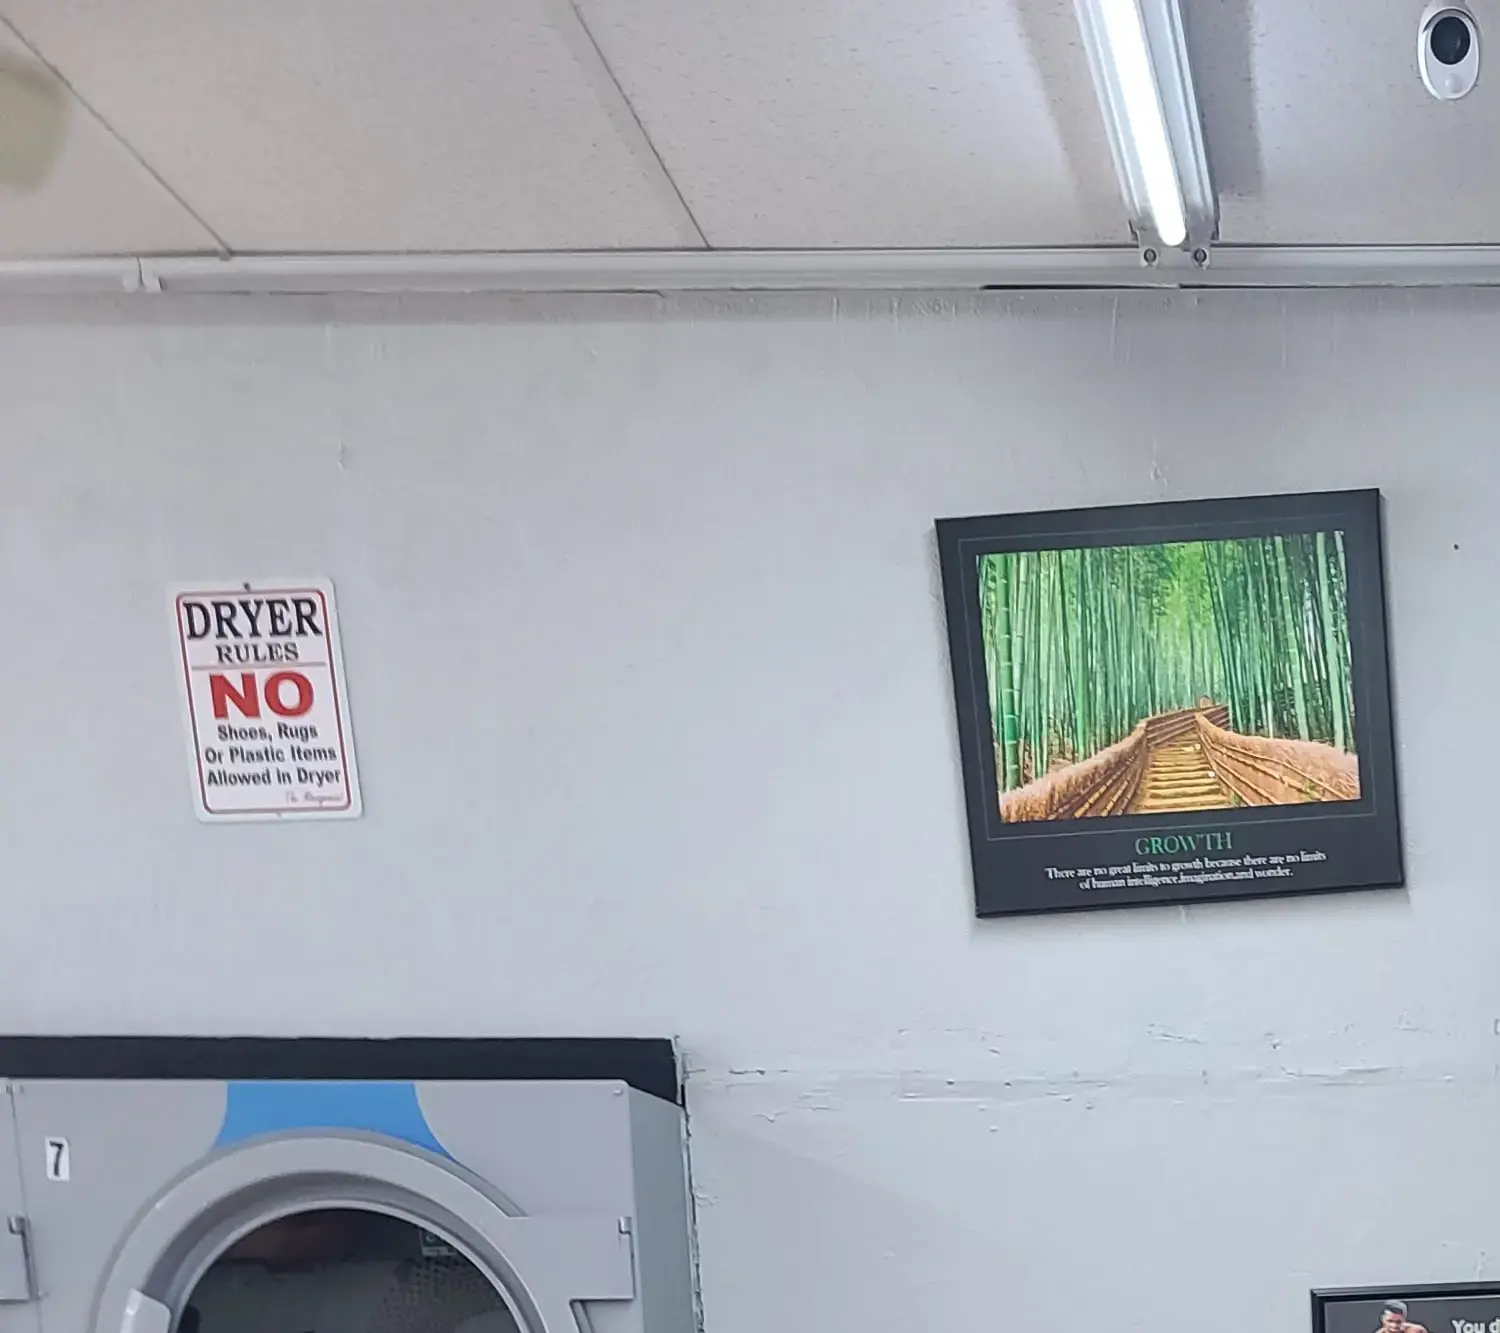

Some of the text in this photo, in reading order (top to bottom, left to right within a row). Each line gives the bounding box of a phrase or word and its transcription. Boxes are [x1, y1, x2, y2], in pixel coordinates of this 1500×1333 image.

[183, 598, 323, 640] DRYER
[216, 641, 299, 664] RULES
[209, 670, 314, 719] NO
[217, 722, 319, 742] Shoes, Rugs
[205, 744, 337, 764] Or Plastic Items
[207, 767, 271, 786] Allowed
[298, 766, 341, 786] Dryer
[1135, 832, 1233, 855] GROWTH
[1045, 850, 1327, 879] There are no great limits to growth because there are no limits
[1079, 878, 1091, 890] of
[1092, 877, 1125, 889] human
[49, 1140, 64, 1177] 7
